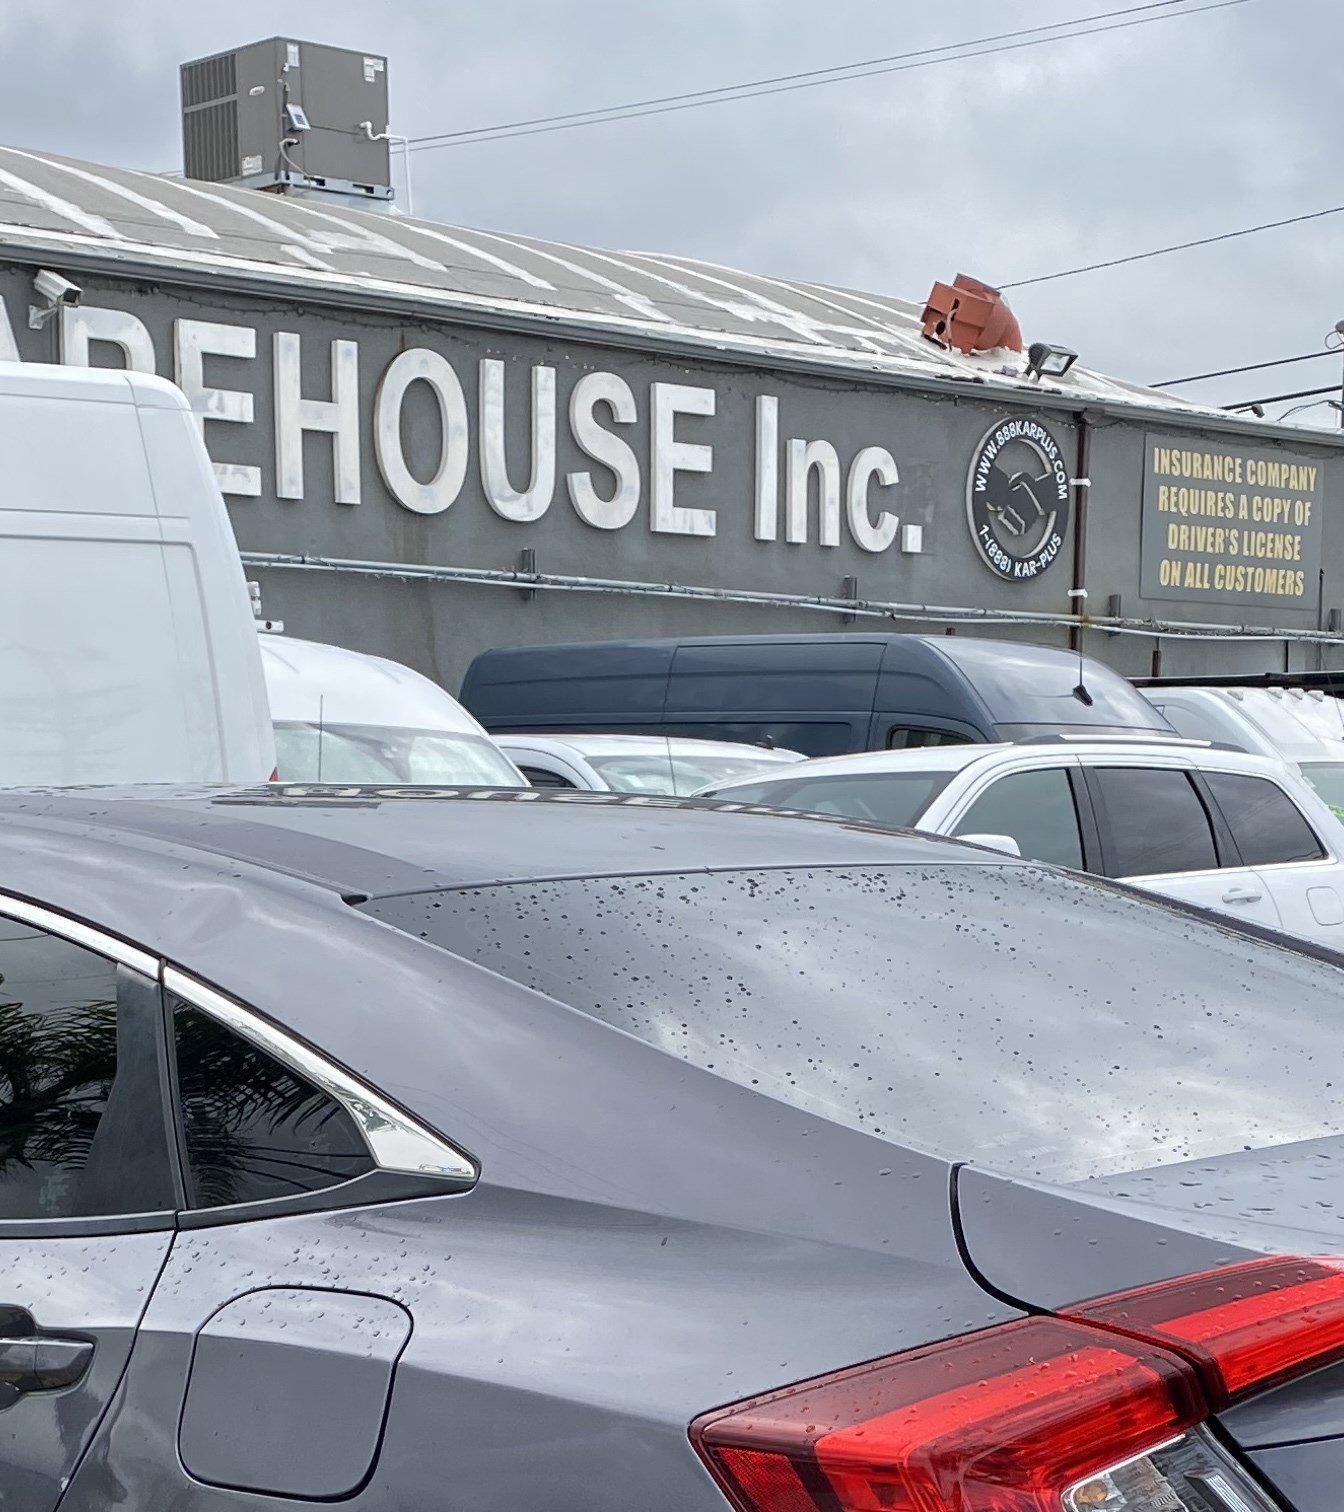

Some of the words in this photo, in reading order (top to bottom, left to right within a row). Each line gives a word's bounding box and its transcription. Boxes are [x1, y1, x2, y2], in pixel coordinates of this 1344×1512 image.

[754, 393, 923, 555] Inc.
[1154, 447, 1243, 483] INSURANCE
[1246, 459, 1317, 491] COMPANY
[1158, 485, 1235, 518] REQUIRES
[1238, 494, 1249, 520] A
[1252, 495, 1292, 524] COPY
[1294, 500, 1312, 526] OF
[1014, 532, 1062, 578] KAR-PLUS
[1167, 523, 1239, 555] DRIVER'S
[1242, 530, 1302, 561] LICENSE
[1159, 559, 1182, 587] ON
[1184, 562, 1210, 589] ALL
[1213, 563, 1305, 596] CUSTOMERS
